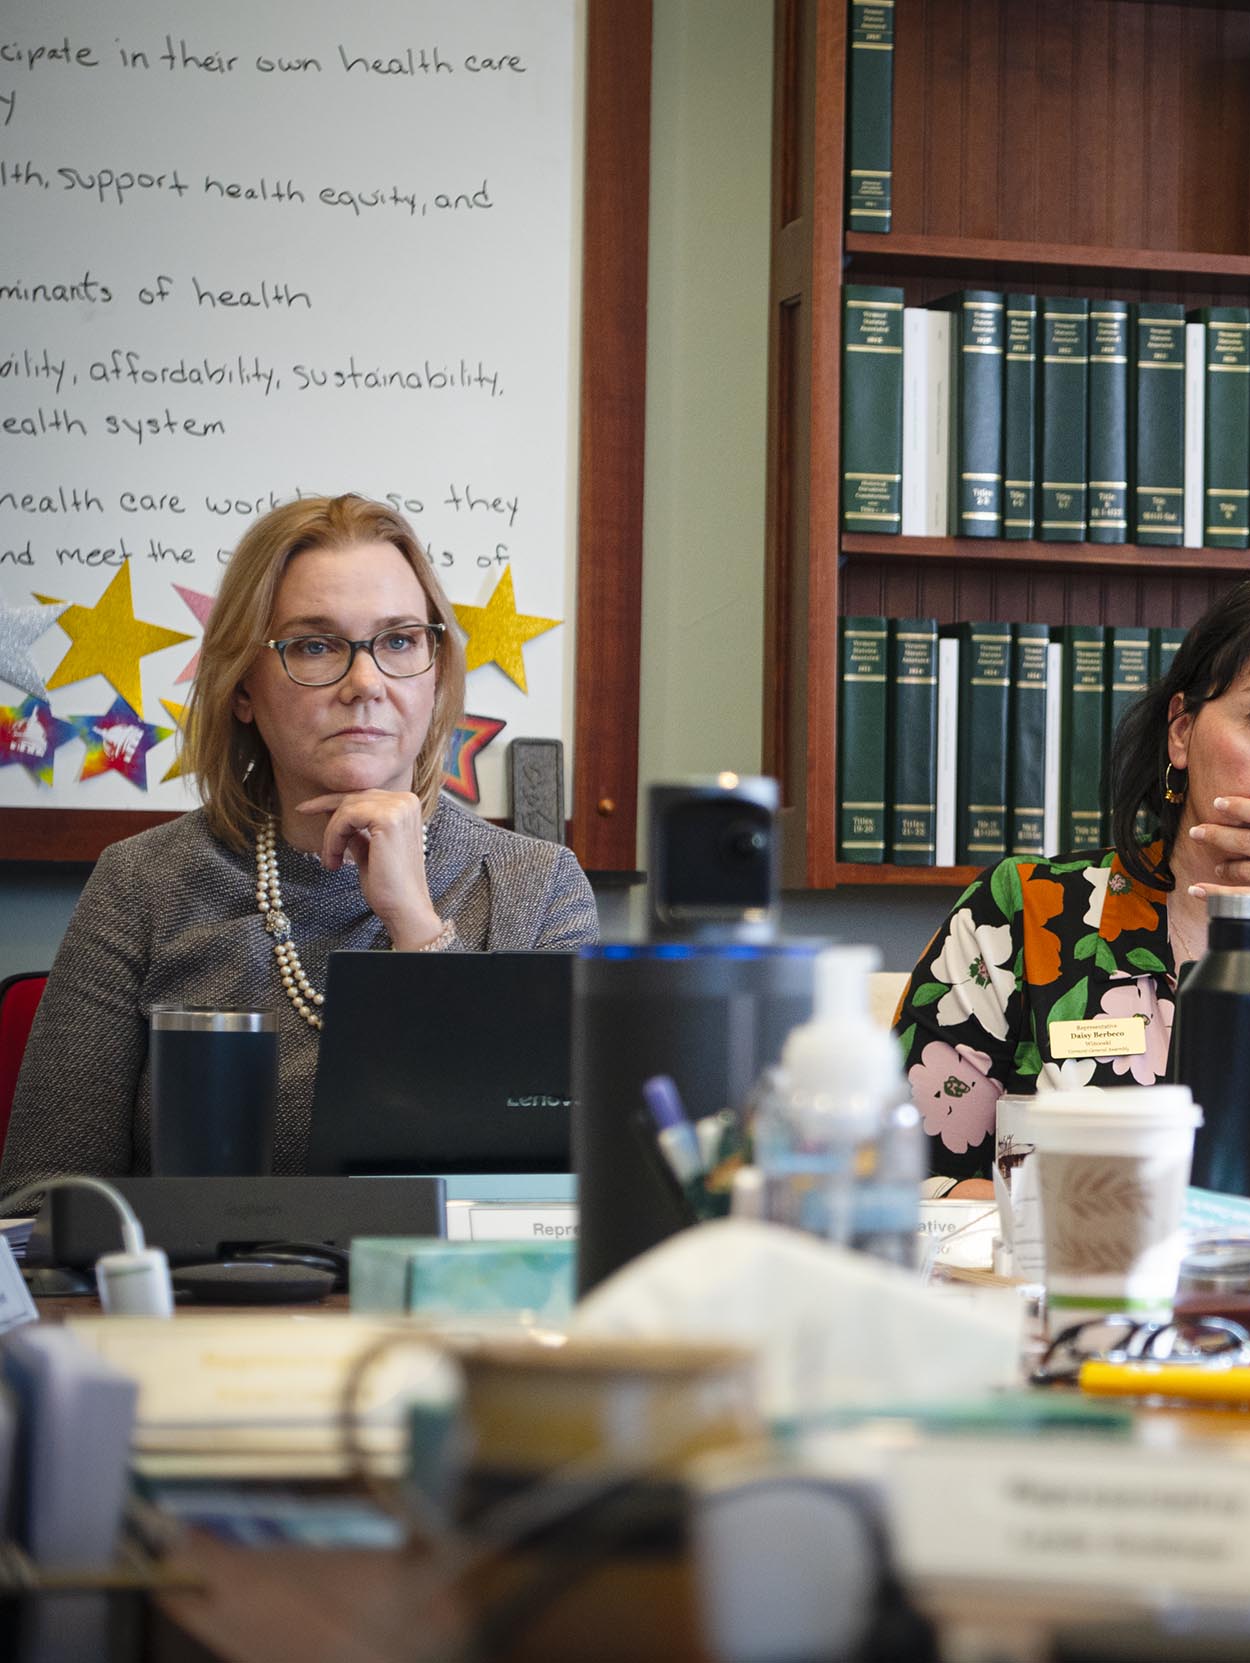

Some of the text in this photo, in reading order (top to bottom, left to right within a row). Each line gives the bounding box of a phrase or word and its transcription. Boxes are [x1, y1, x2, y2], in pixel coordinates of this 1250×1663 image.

[0, 35, 528, 75] cipate in their own health care
[57, 168, 189, 205] support
[204, 177, 305, 204] health
[319, 183, 427, 217] equity,
[434, 180, 494, 209] and
[139, 276, 174, 305] of
[192, 276, 312, 309] health
[90, 349, 281, 395] affordability,
[293, 358, 504, 396] sustainability,
[105, 412, 226, 445] system
[120, 492, 186, 513] care
[444, 484, 518, 527] they
[56, 537, 132, 567] meet
[148, 539, 196, 563] the
[477, 543, 510, 568] of
[1070, 1031, 1125, 1041] Daisy Berbeco
[1076, 1023, 1117, 1031] Representative
